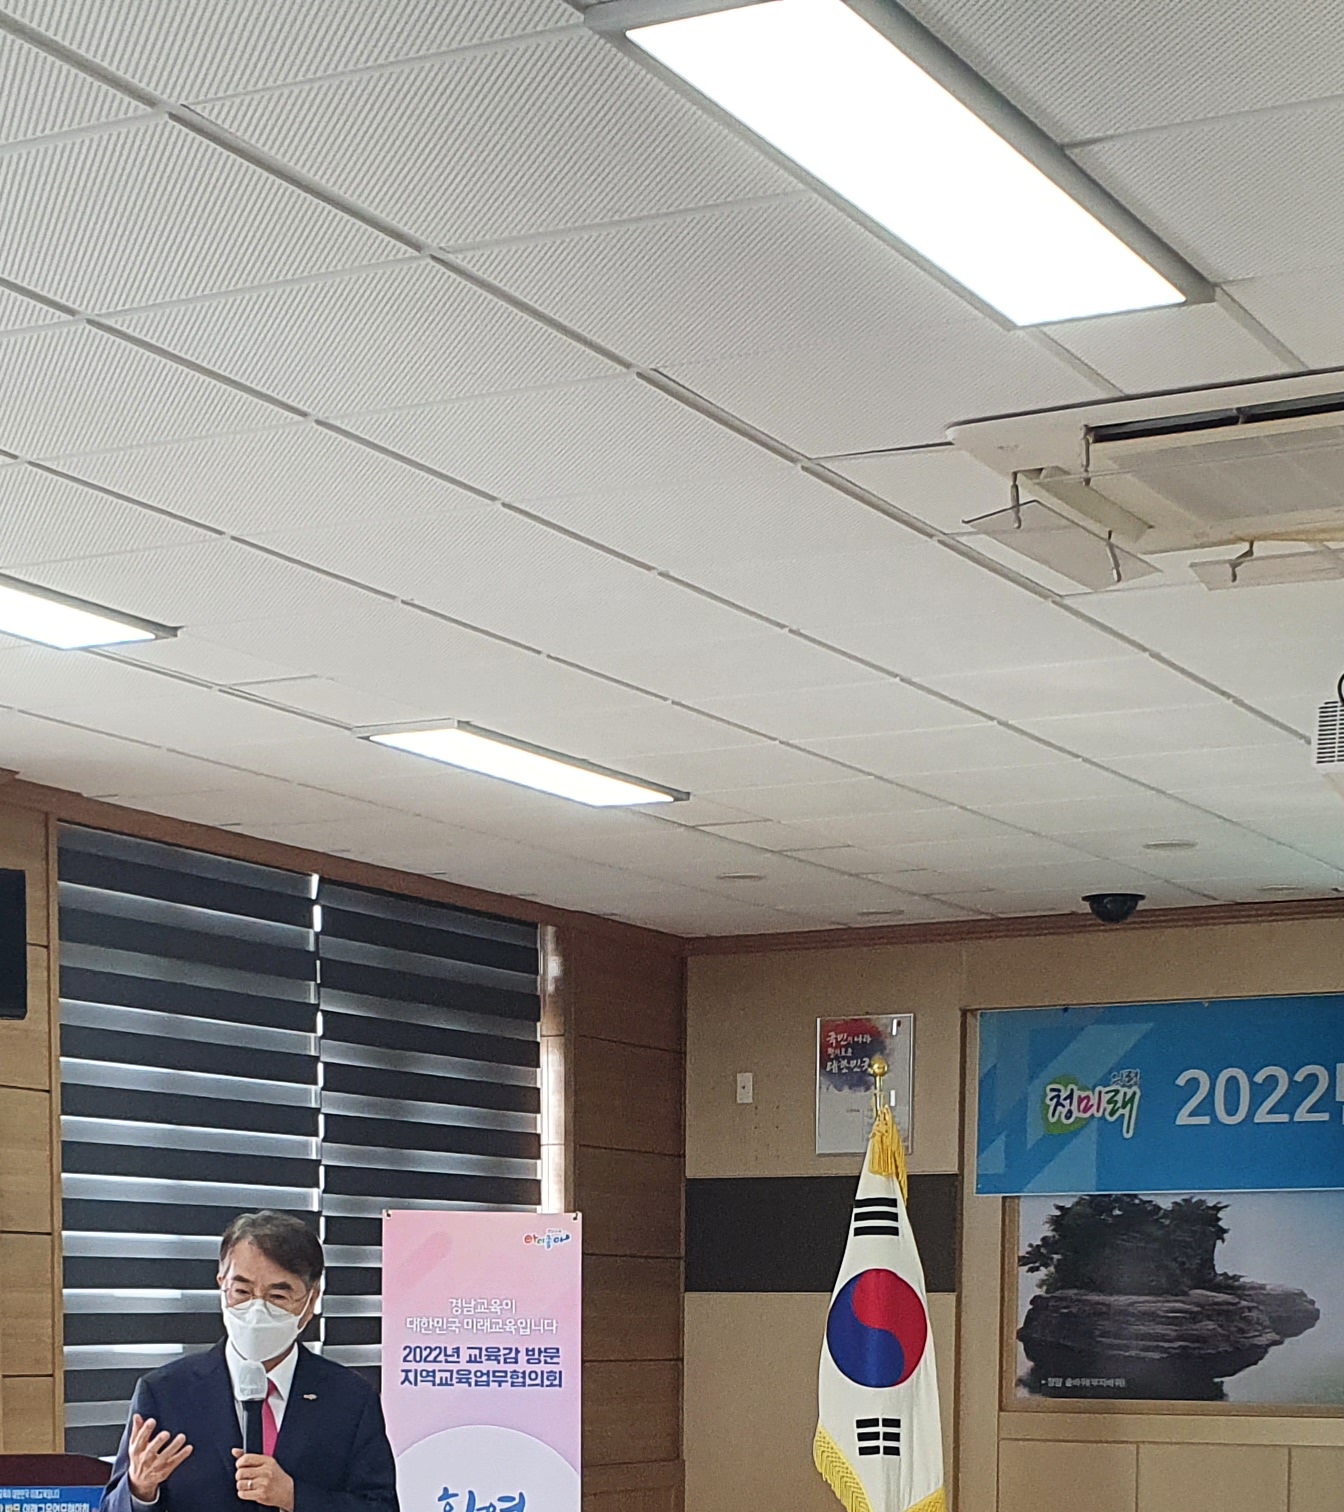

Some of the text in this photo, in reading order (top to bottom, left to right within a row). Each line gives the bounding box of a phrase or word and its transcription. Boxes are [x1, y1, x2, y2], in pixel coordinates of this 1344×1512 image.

[1046, 1084, 1141, 1139] 청미래
[448, 1298, 516, 1315] 경남교육이
[406, 1317, 558, 1335] 대한민국 미래교육입니다
[402, 1345, 561, 1365] 2022년 교육감 방문
[400, 1368, 563, 1388] 지역교육업무협의회
